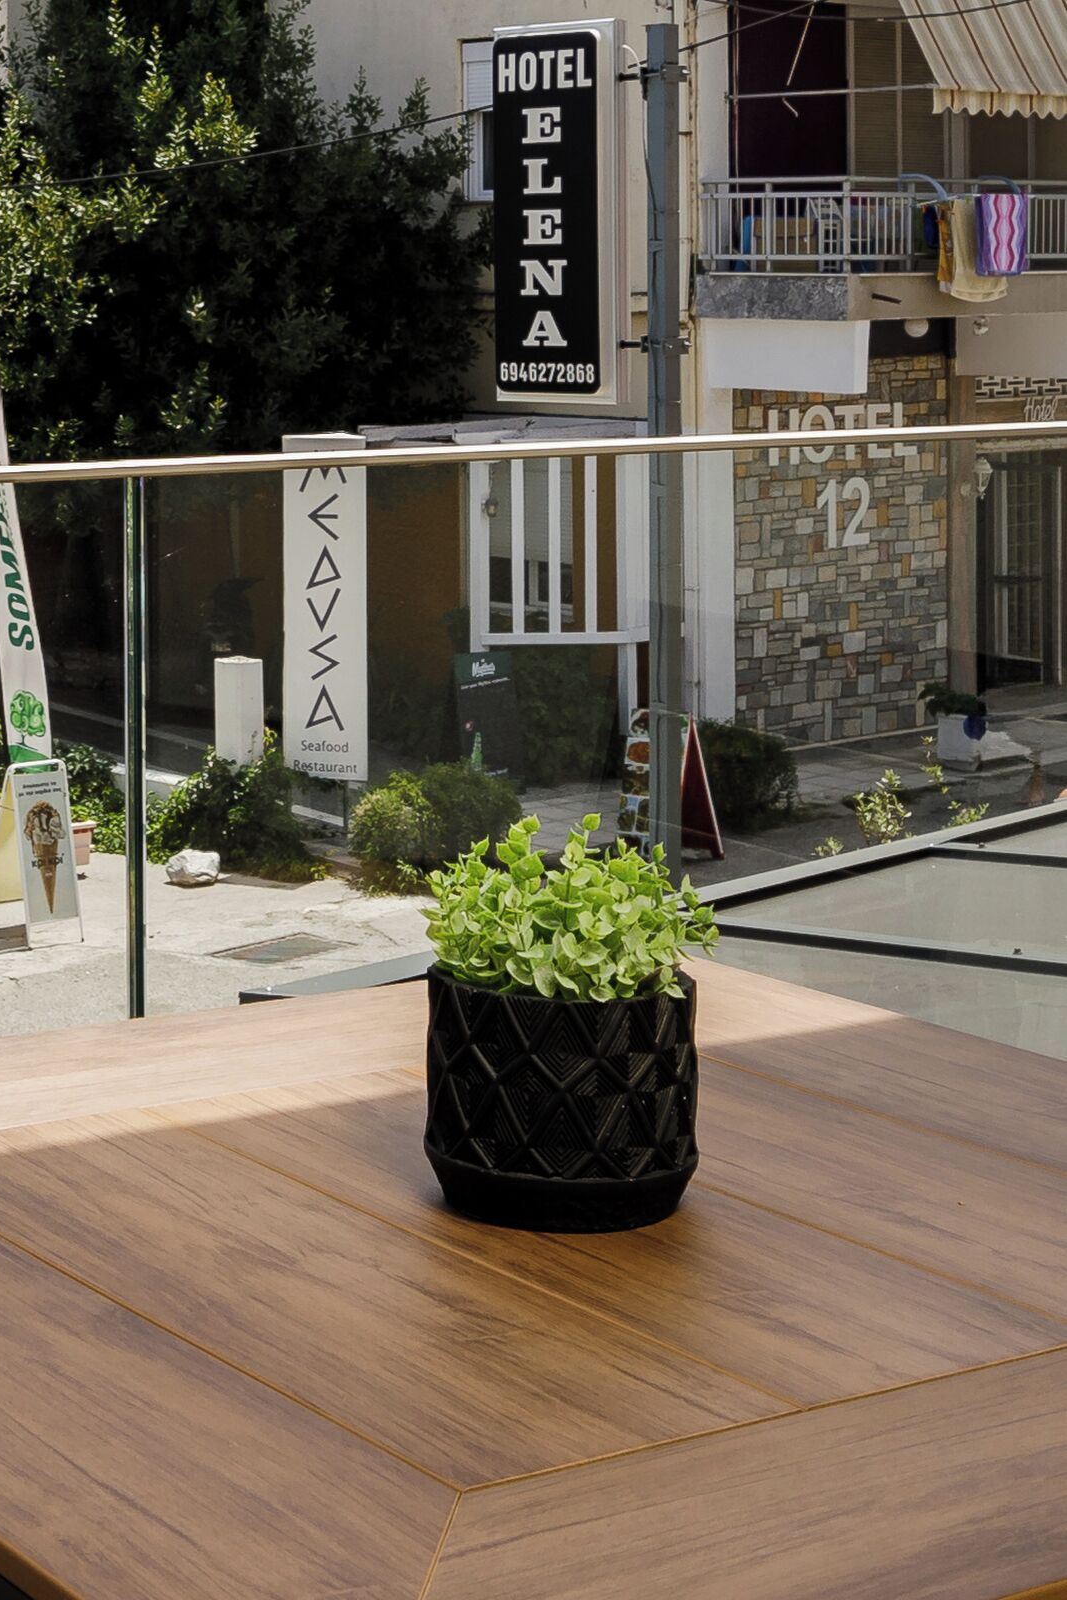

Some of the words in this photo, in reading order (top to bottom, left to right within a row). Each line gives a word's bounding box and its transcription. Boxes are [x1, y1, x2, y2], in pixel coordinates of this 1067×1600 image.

[498, 48, 592, 92] HOTEL
[521, 106, 568, 347] ELENA
[500, 362, 595, 383] 6946272868
[1023, 396, 1058, 422] Hotel
[768, 402, 918, 466] HOTEL
[816, 476, 870, 549] 12
[301, 740, 349, 753] Seafood
[293, 759, 357, 773] Restaurant
